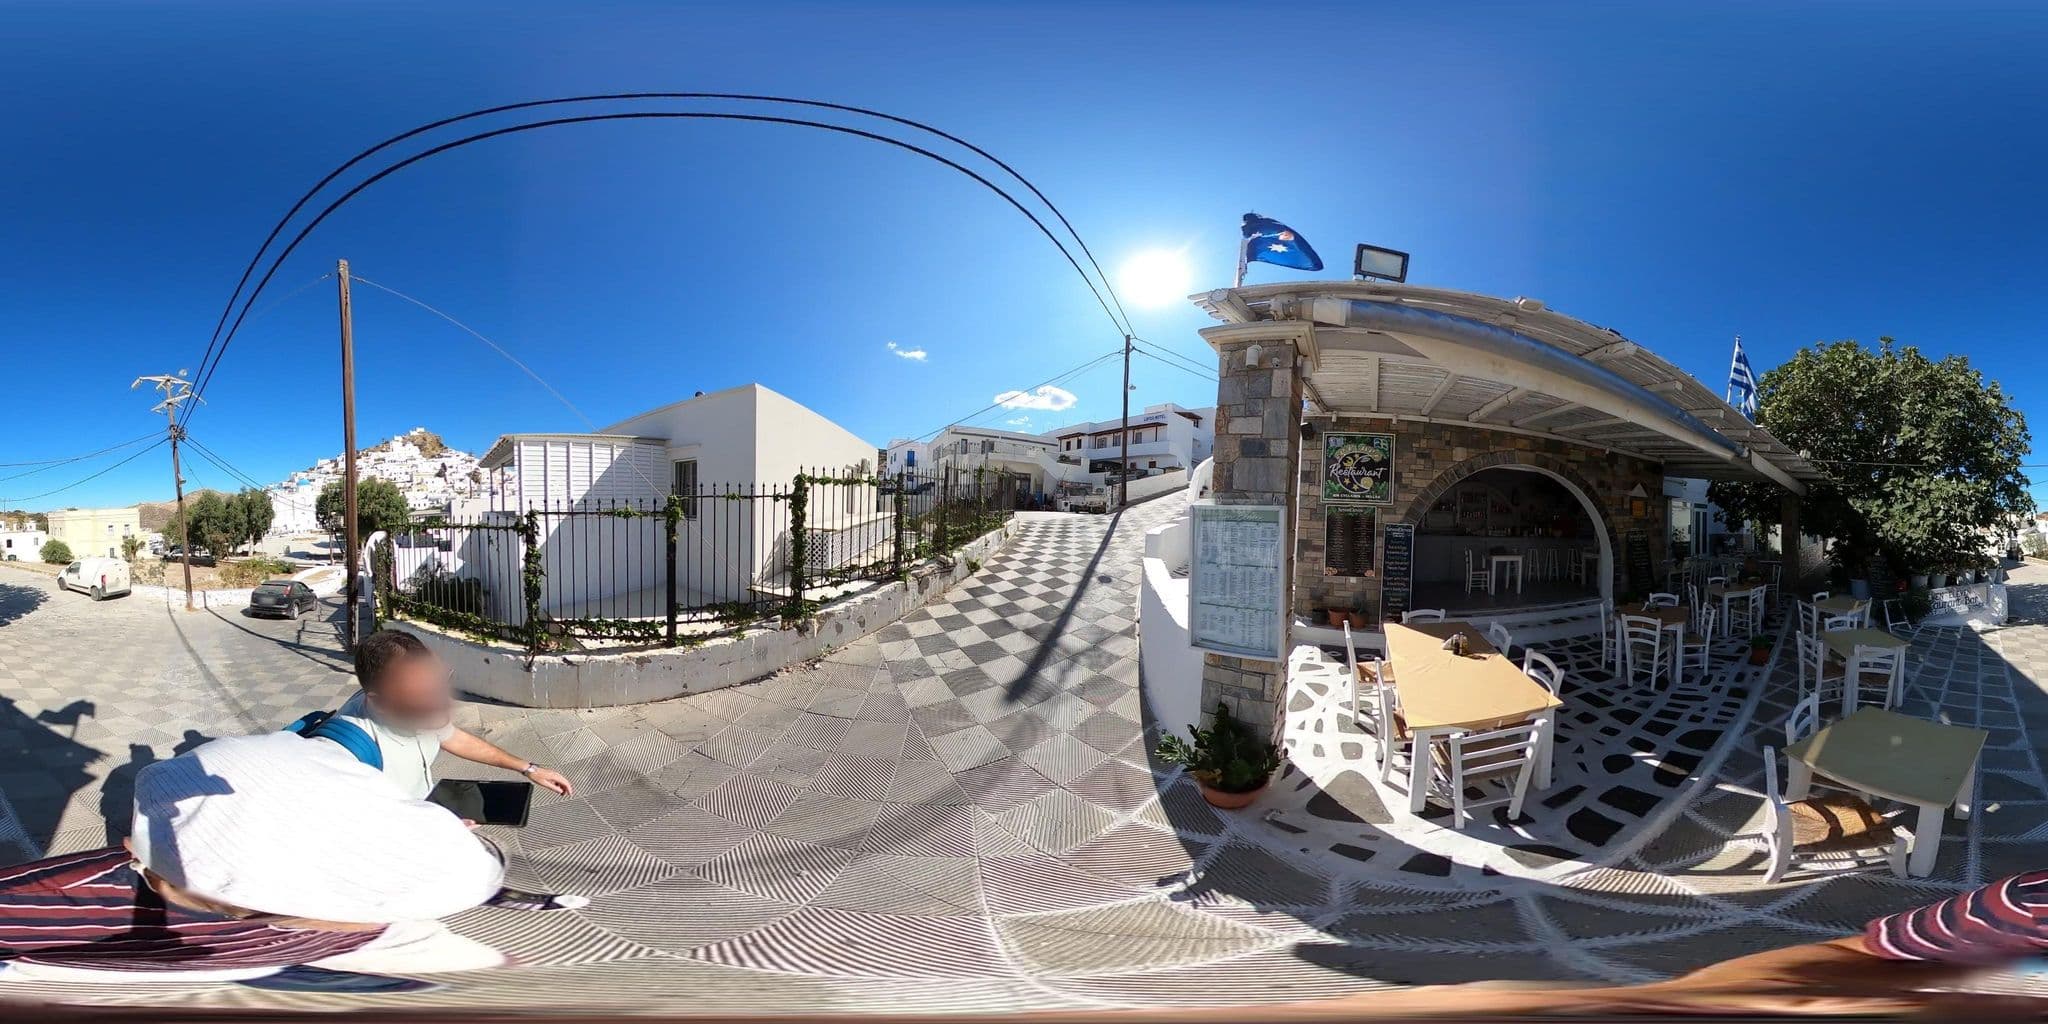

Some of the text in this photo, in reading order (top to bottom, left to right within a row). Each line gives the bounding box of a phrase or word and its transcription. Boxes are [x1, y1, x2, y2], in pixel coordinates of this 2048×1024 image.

[1329, 463, 1388, 479] Restaurant
[1933, 598, 1961, 610] aurant
[1965, 596, 1978, 605] Bar
